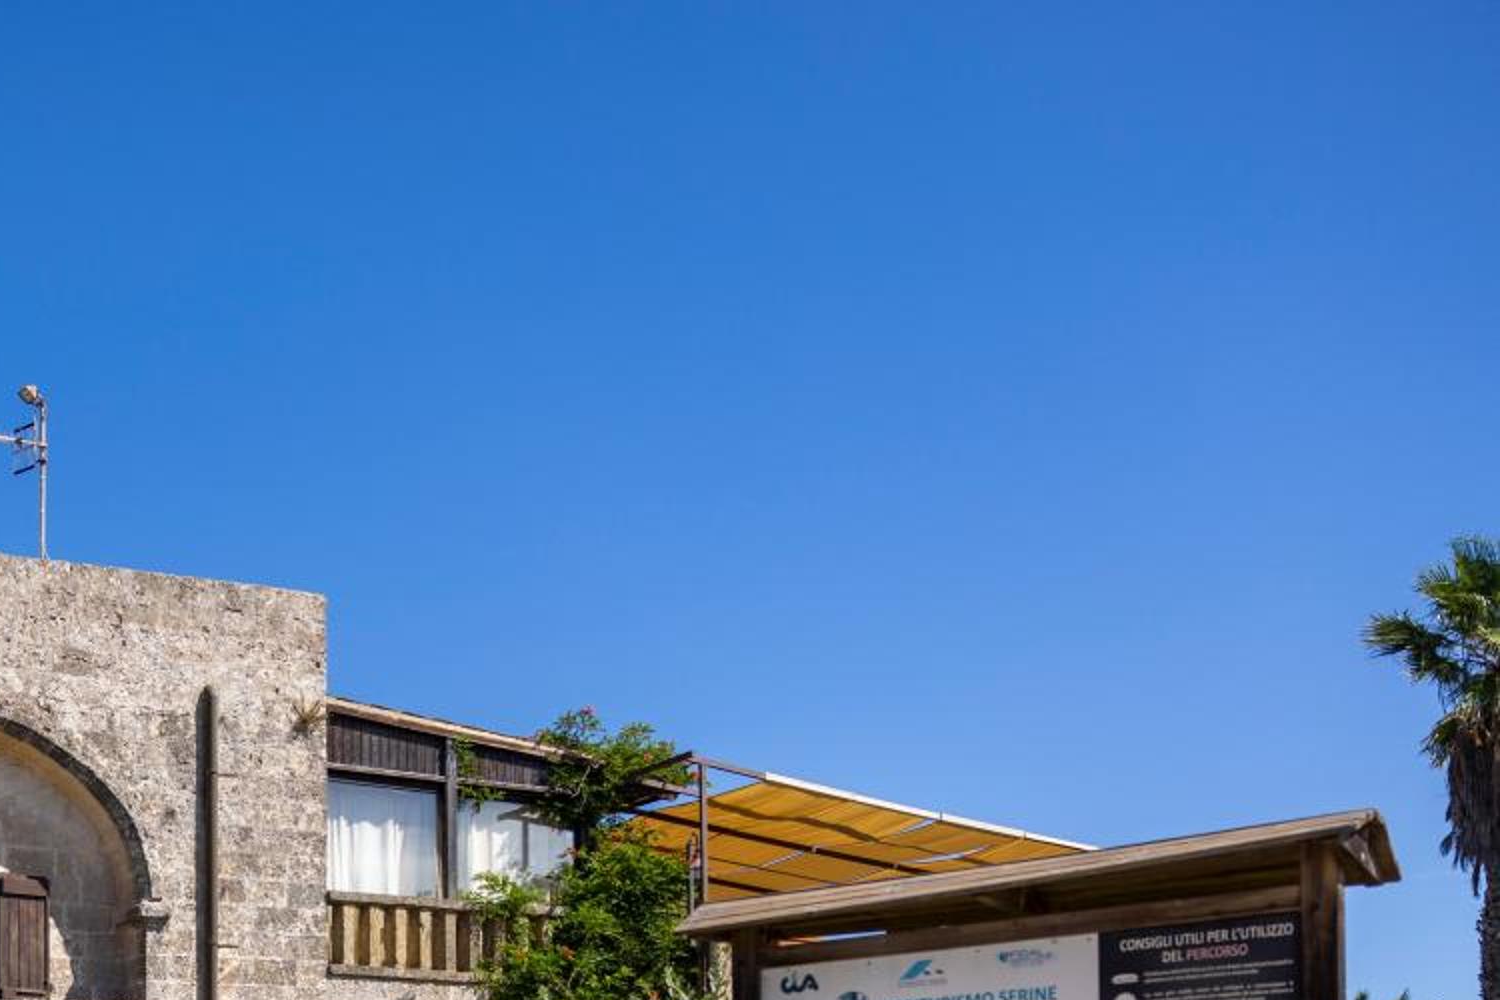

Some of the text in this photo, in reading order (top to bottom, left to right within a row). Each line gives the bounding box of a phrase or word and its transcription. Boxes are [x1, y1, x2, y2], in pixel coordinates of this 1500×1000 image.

[1119, 935, 1172, 952] CONSIGLI
[1175, 932, 1204, 947] UTILI
[1207, 930, 1228, 943] PER
[1162, 943, 1248, 963] DEL PERCORSO
